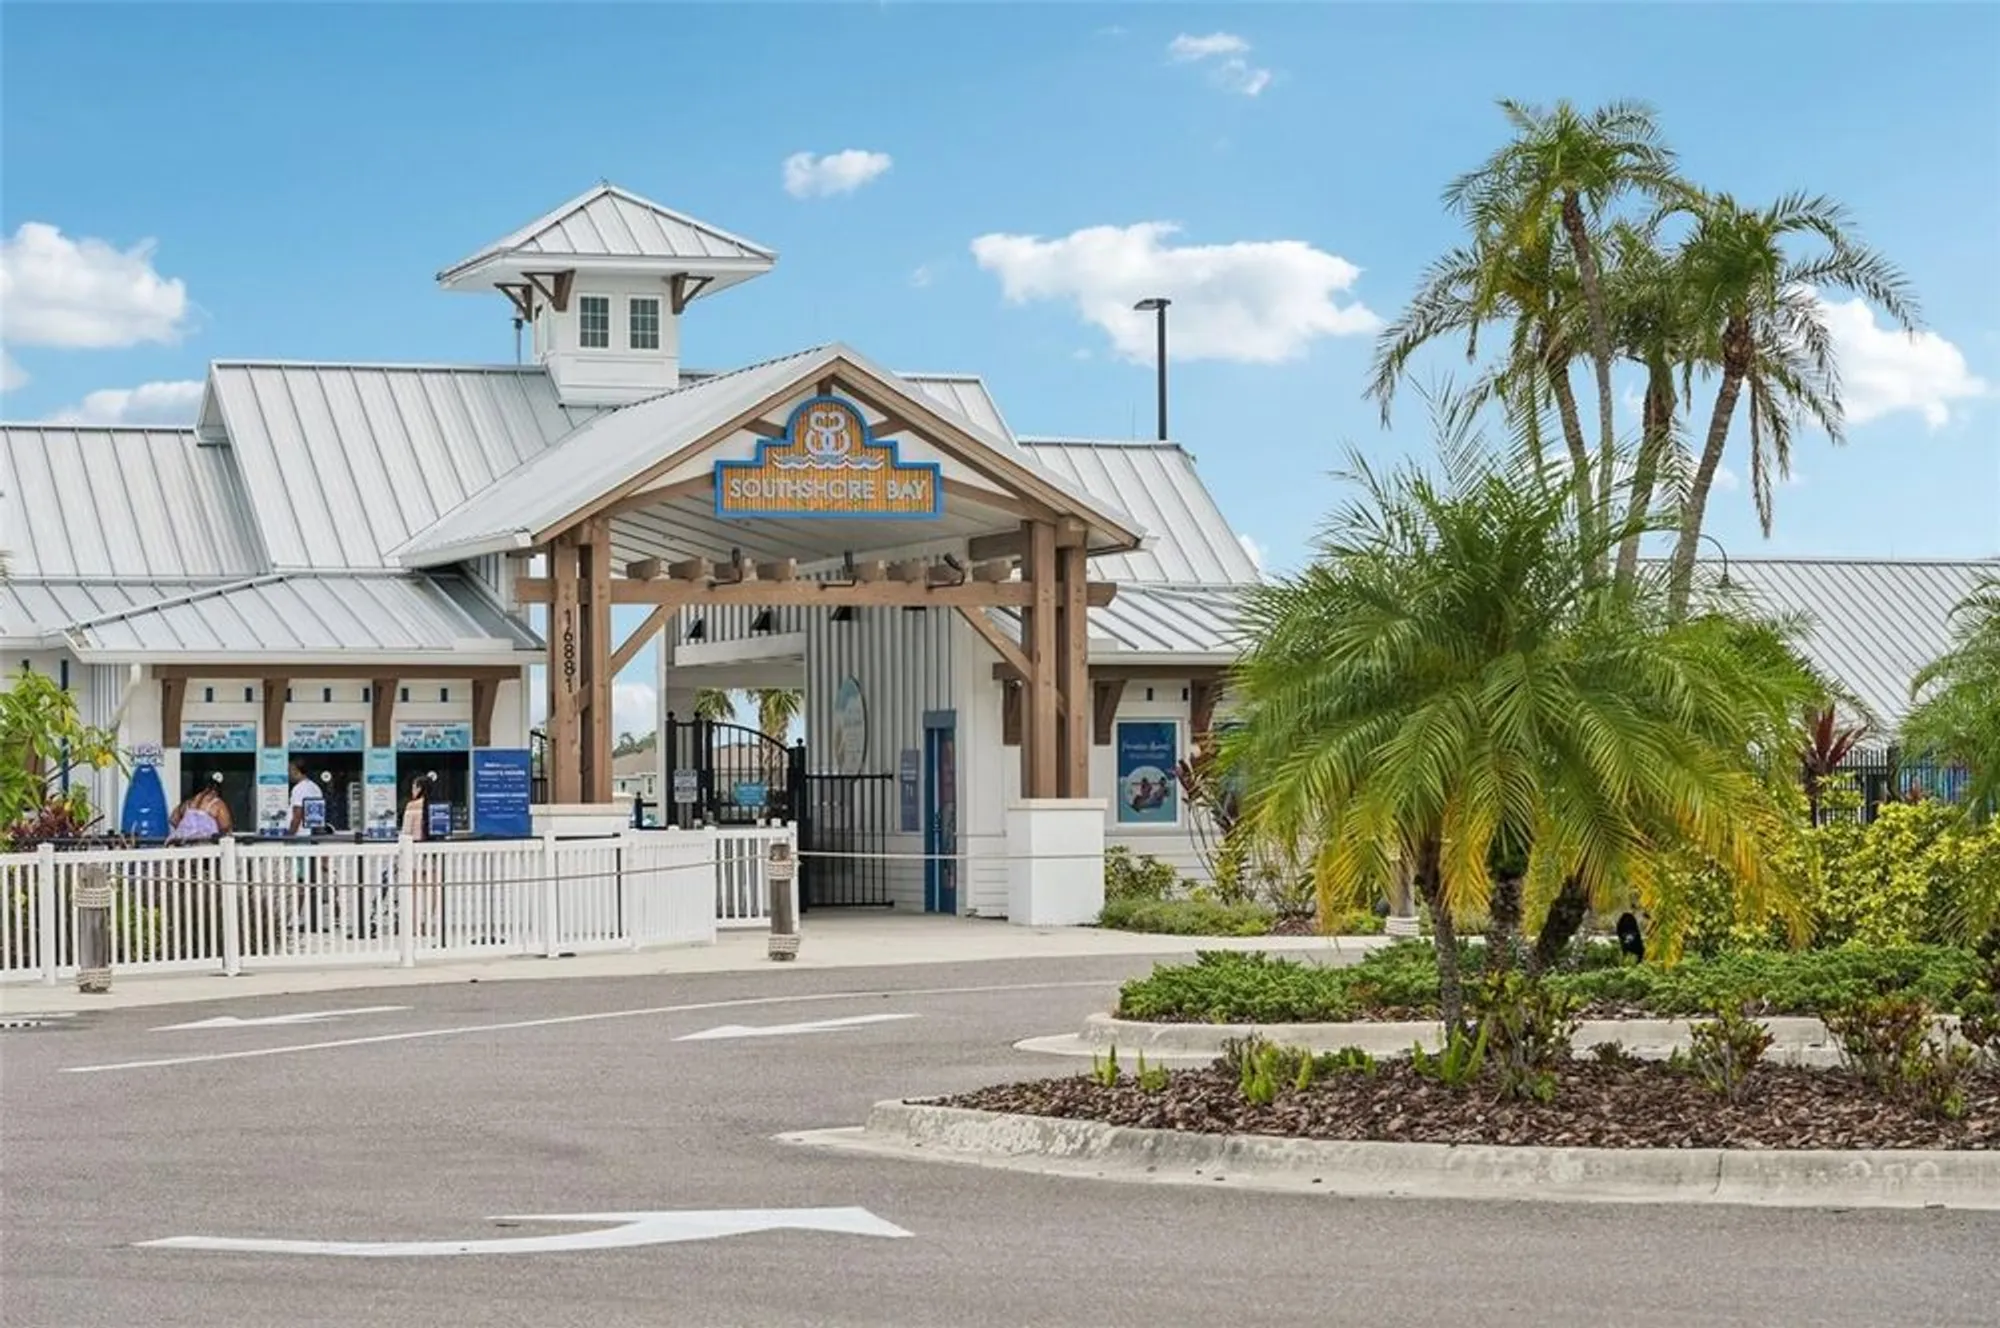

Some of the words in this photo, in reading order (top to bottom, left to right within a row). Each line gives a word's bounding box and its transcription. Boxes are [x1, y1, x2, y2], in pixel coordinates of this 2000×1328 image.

[730, 478, 875, 499] SOUTHSHORE
[886, 478, 926, 499] BAY
[563, 608, 575, 694] 16881
